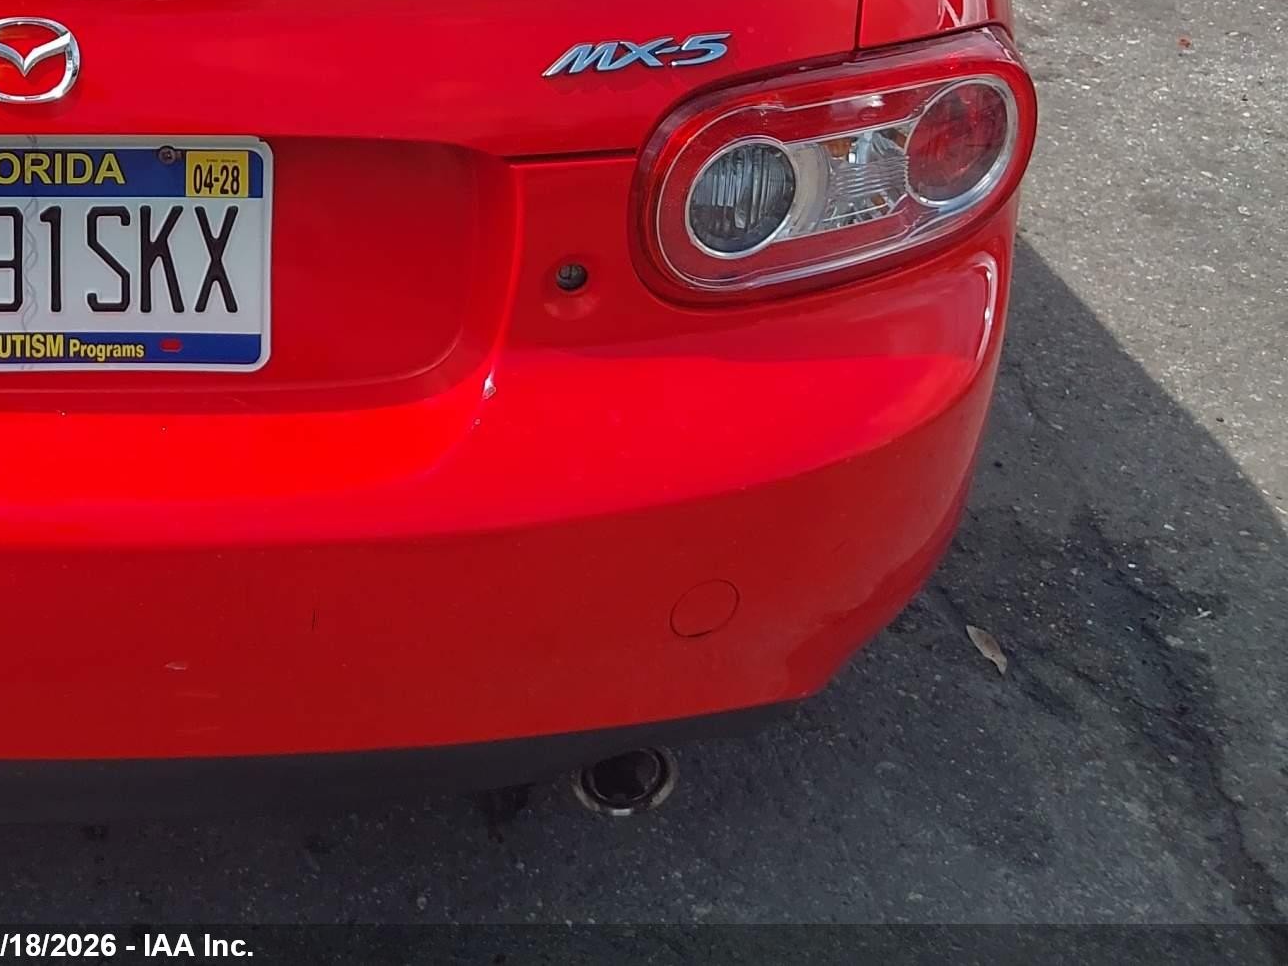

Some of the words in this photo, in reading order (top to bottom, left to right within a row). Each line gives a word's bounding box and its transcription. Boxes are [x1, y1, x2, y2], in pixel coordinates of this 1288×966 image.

[541, 31, 733, 77] MX-5
[193, 163, 240, 195] 04-28
[68, 338, 145, 362] Programs
